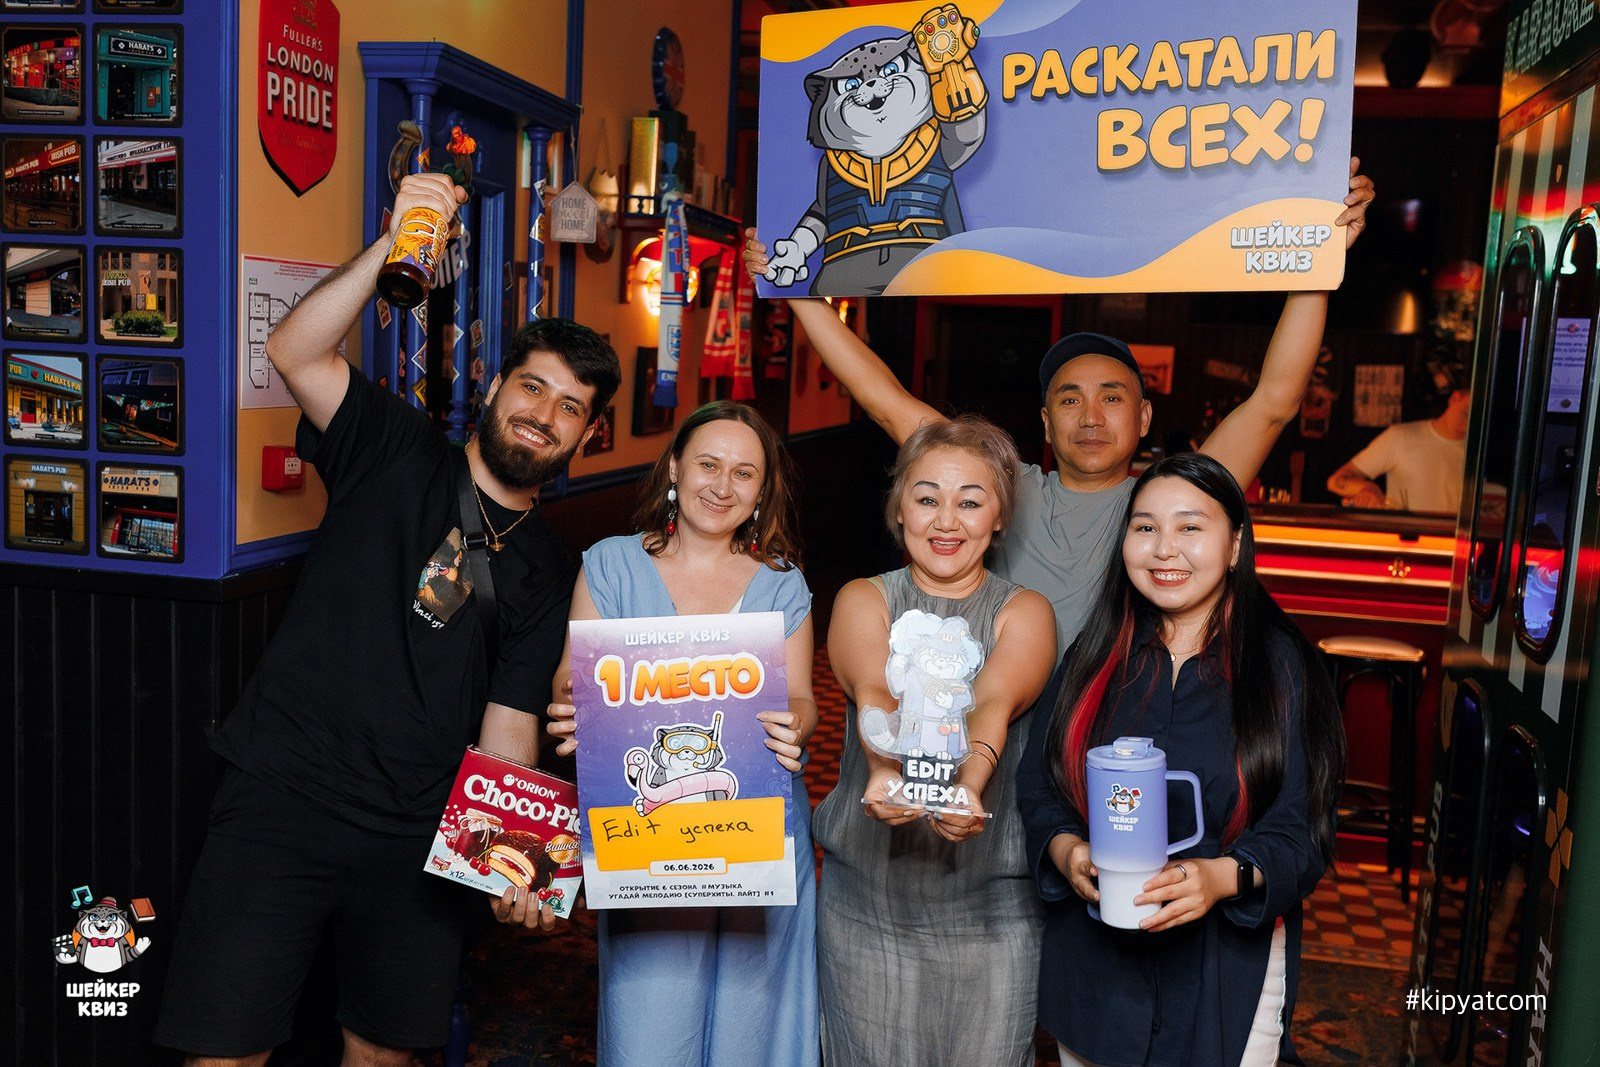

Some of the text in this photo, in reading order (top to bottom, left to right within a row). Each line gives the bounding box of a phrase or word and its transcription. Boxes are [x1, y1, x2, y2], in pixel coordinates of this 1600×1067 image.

[283, 24, 323, 52] FULLER'S
[267, 42, 334, 83] LONDON
[1003, 29, 1337, 102] РАСКАТАЛИ
[267, 71, 333, 129] PRIDE
[1098, 98, 1327, 173] ВСЕХ!
[561, 197, 587, 209] HOME
[560, 219, 586, 231] HOME
[1230, 222, 1332, 250] ШЕЙКЕР
[1245, 249, 1313, 274] КВИЗ
[9, 363, 22, 375] PUB
[624, 629, 730, 646] ШЕЙКЕР КВИЗ
[598, 656, 762, 703] 1 МЕСТО
[906, 759, 955, 782] EDIT
[886, 779, 969, 805] УСПЕХА
[602, 818, 754, 844] Edit успеха
[1108, 815, 1139, 825] ШЕЙКЕР
[1113, 823, 1133, 832] КВИЗ
[663, 863, 715, 873] 06.06.2026
[608, 892, 640, 900] УГАДАЙ
[642, 891, 683, 899] МЕЛОДИЮ
